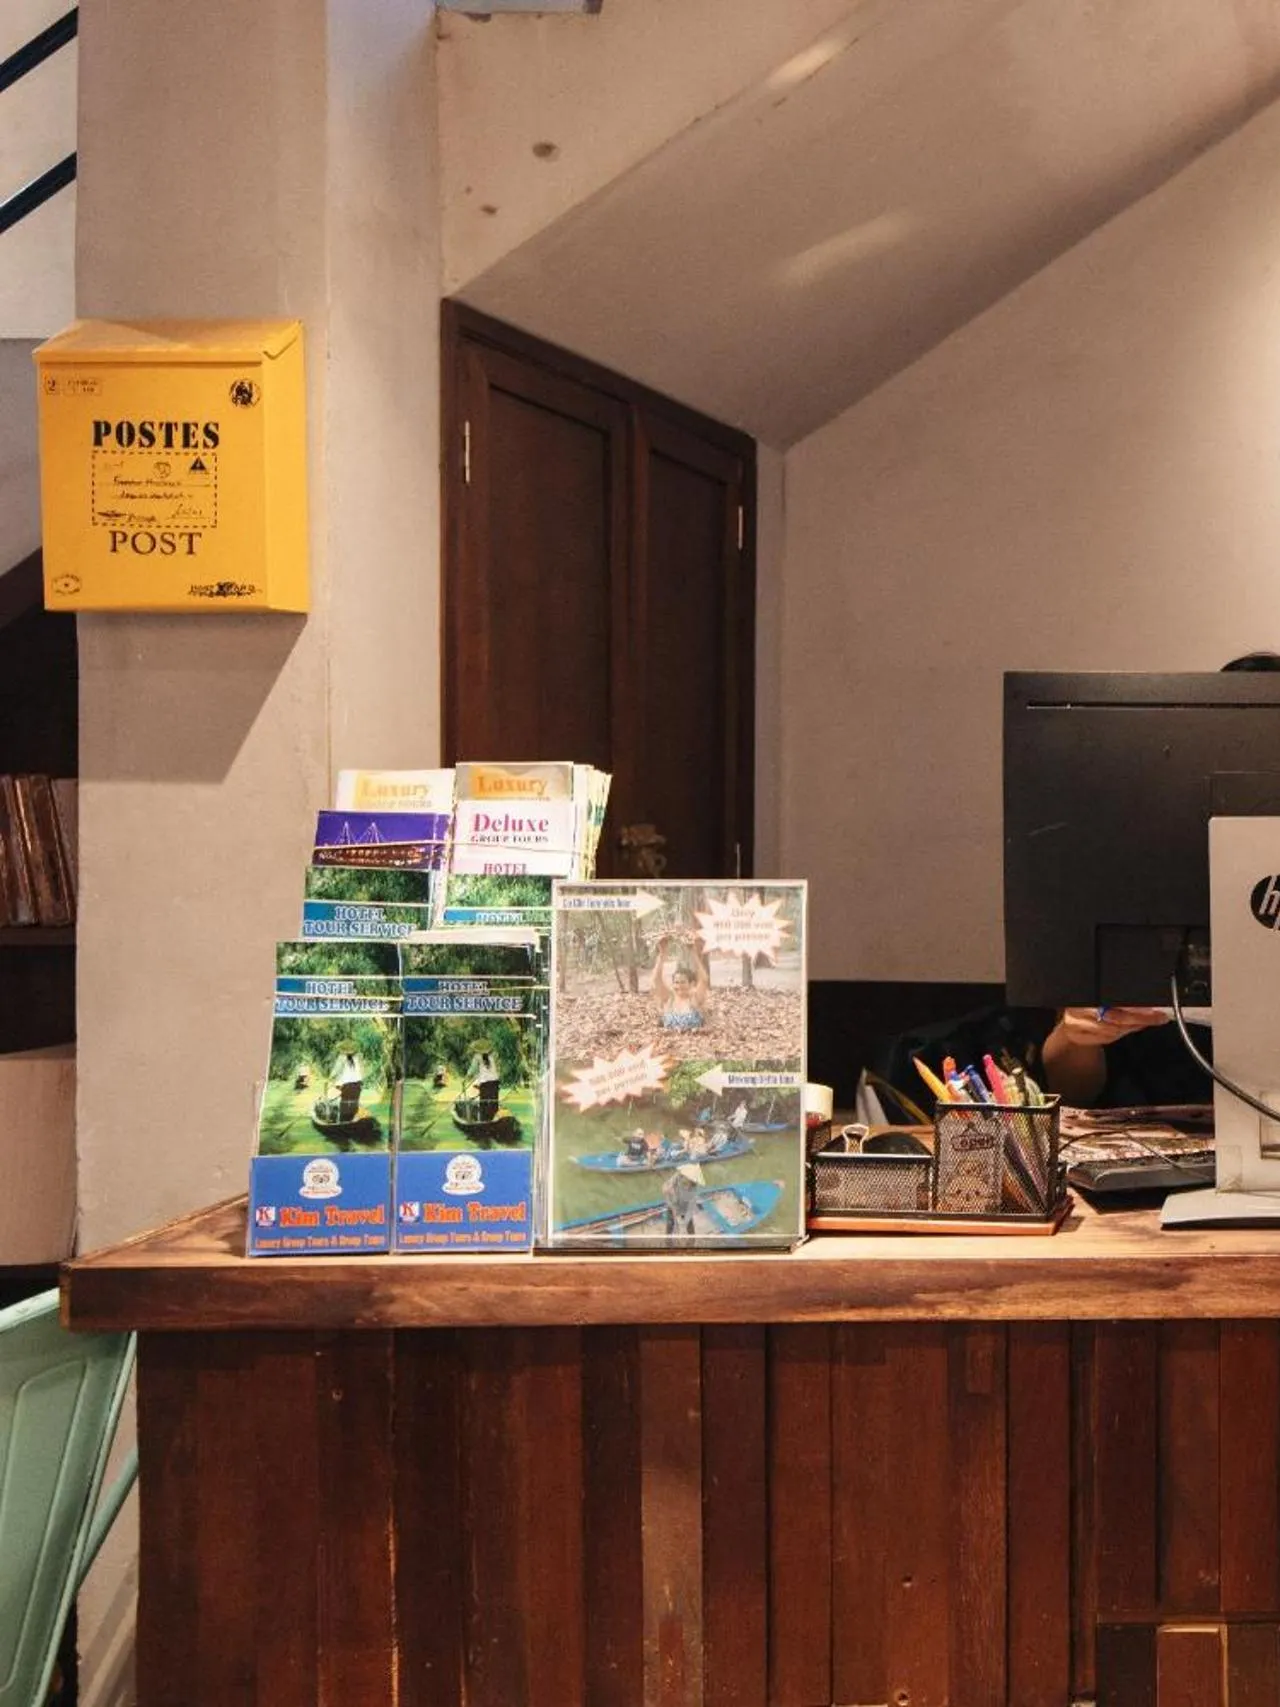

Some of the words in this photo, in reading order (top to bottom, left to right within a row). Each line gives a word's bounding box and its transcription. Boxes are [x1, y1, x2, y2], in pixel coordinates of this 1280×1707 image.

[92, 420, 220, 449] POSTES
[109, 530, 202, 556] POST
[361, 777, 430, 799] Luxury
[476, 775, 547, 796] Luxury
[474, 813, 549, 832] Deluxe
[484, 863, 527, 875] HOTEL
[335, 906, 385, 921] HOTEL
[305, 921, 347, 936] TOUR
[305, 982, 355, 995] HOTEL
[438, 981, 488, 995] HOTEL
[276, 998, 317, 1012] TOUR
[319, 998, 389, 1012] SERVICE
[407, 996, 451, 1011] TOUR
[453, 997, 521, 1011] SERVICE
[280, 1206, 320, 1228] Kim
[325, 1203, 385, 1227] Travel
[423, 1202, 463, 1224] Kim
[466, 1200, 526, 1224] Travel
